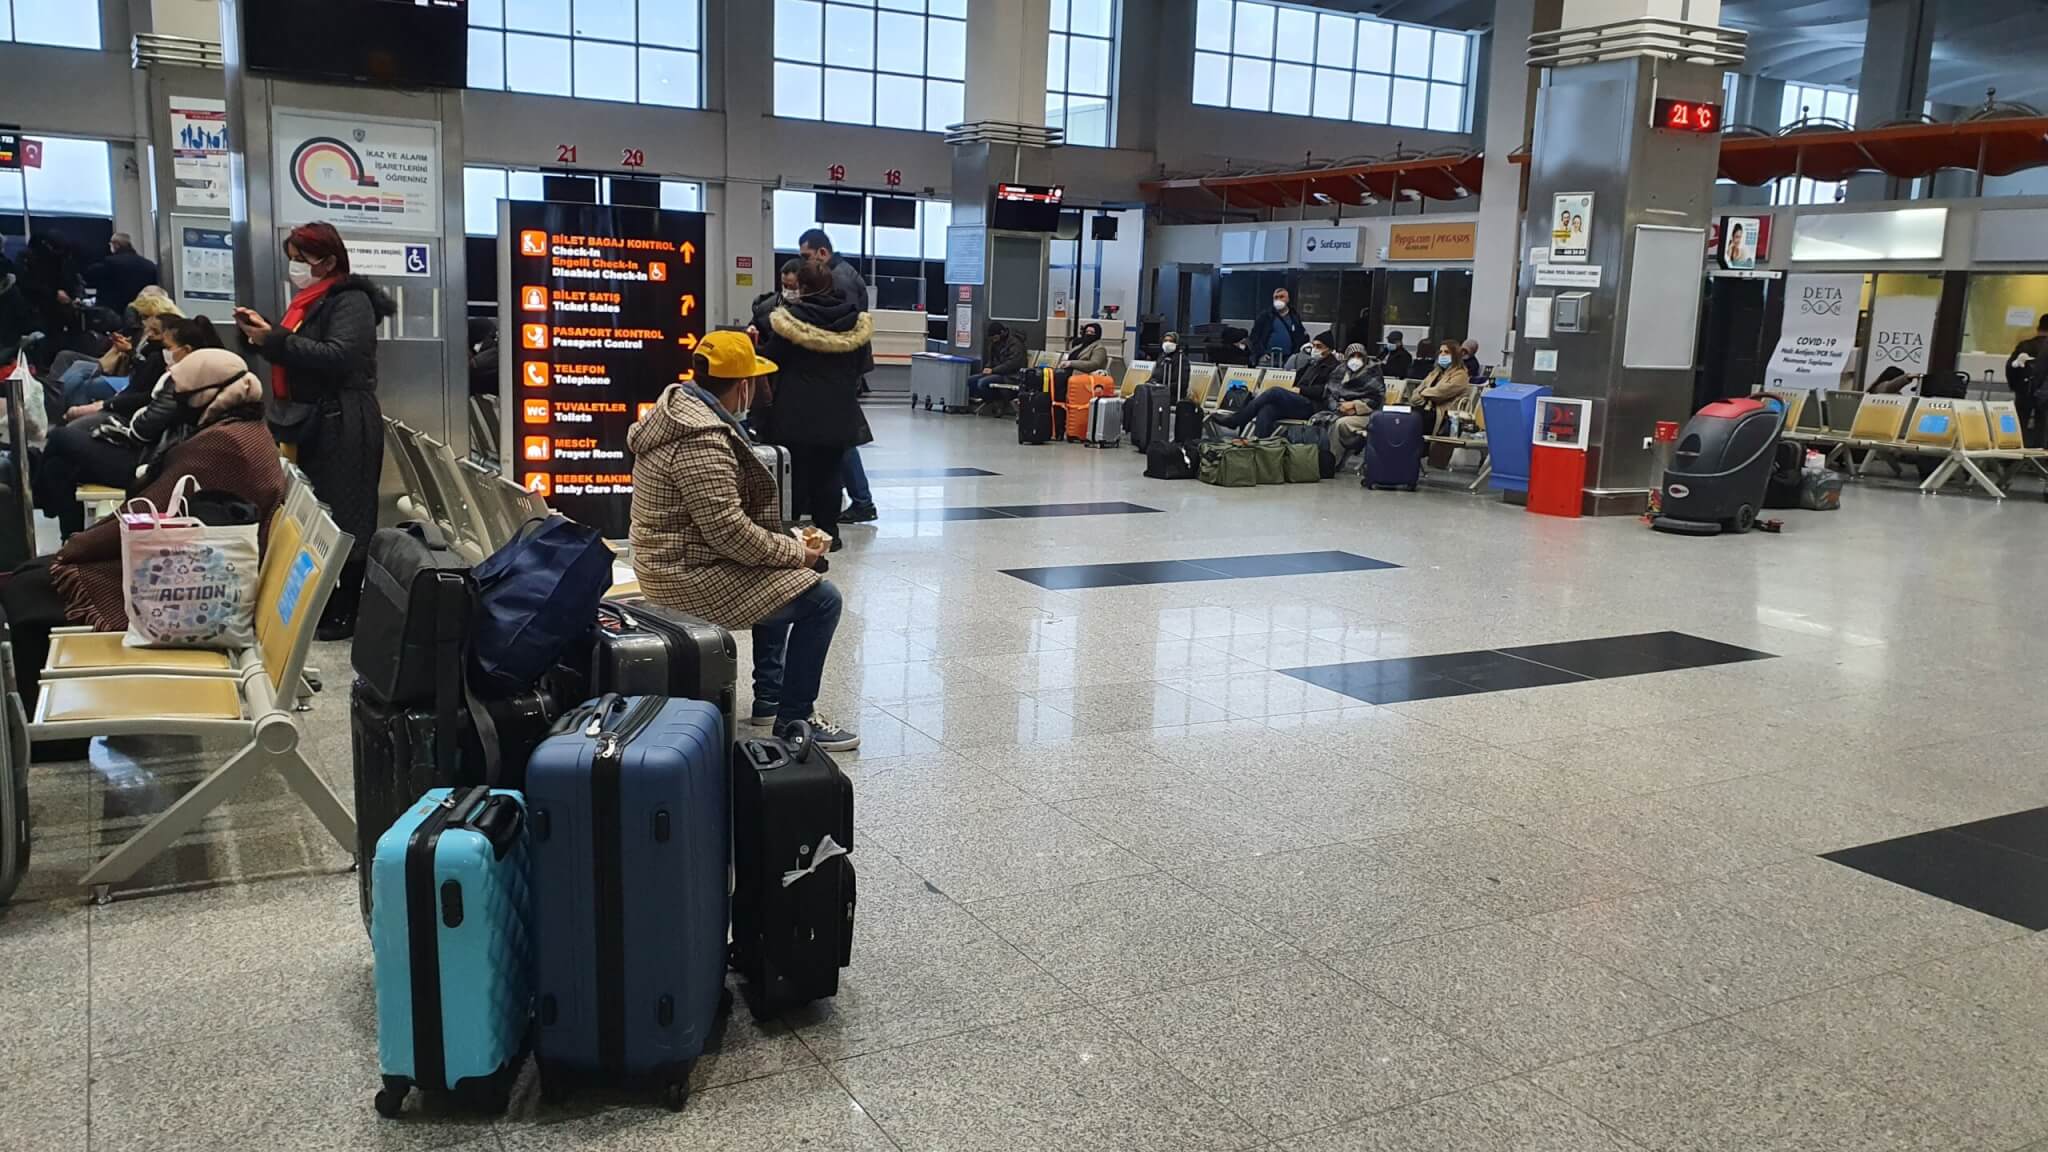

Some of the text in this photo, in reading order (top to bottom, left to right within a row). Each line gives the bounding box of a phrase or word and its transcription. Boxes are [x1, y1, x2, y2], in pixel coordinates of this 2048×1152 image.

[1673, 104, 1688, 124] 21
[387, 152, 398, 160] VE
[400, 152, 428, 161] ALARM
[556, 144, 577, 163] 21
[622, 148, 644, 167] 20
[827, 164, 845, 181] 19
[884, 168, 901, 186] 18
[552, 234, 675, 250] BİLET BAGAJ KONTROL
[552, 246, 600, 257] Check-In
[552, 267, 648, 281] Disabled Check-In
[553, 290, 621, 304] BİLET SATIŞ
[1803, 287, 1842, 299] DETA
[553, 301, 620, 313] Ticket Sales
[553, 326, 664, 340] PASAPORT KONTROL
[1878, 331, 1923, 345] DETA
[553, 337, 643, 350] Passport Control
[1796, 336, 1837, 346] COVID-19
[554, 364, 606, 374] TELEFON
[554, 375, 611, 386] Telephone
[527, 406, 547, 416] WC
[554, 402, 627, 412] TUVALETLER
[554, 412, 592, 422] Toilets
[554, 437, 598, 448] MESCİT
[554, 449, 623, 460] Prayer Room
[555, 474, 632, 484] BEBEK BAKIM
[555, 484, 634, 496] Baby Care Roo
[158, 584, 226, 602] ACTION
